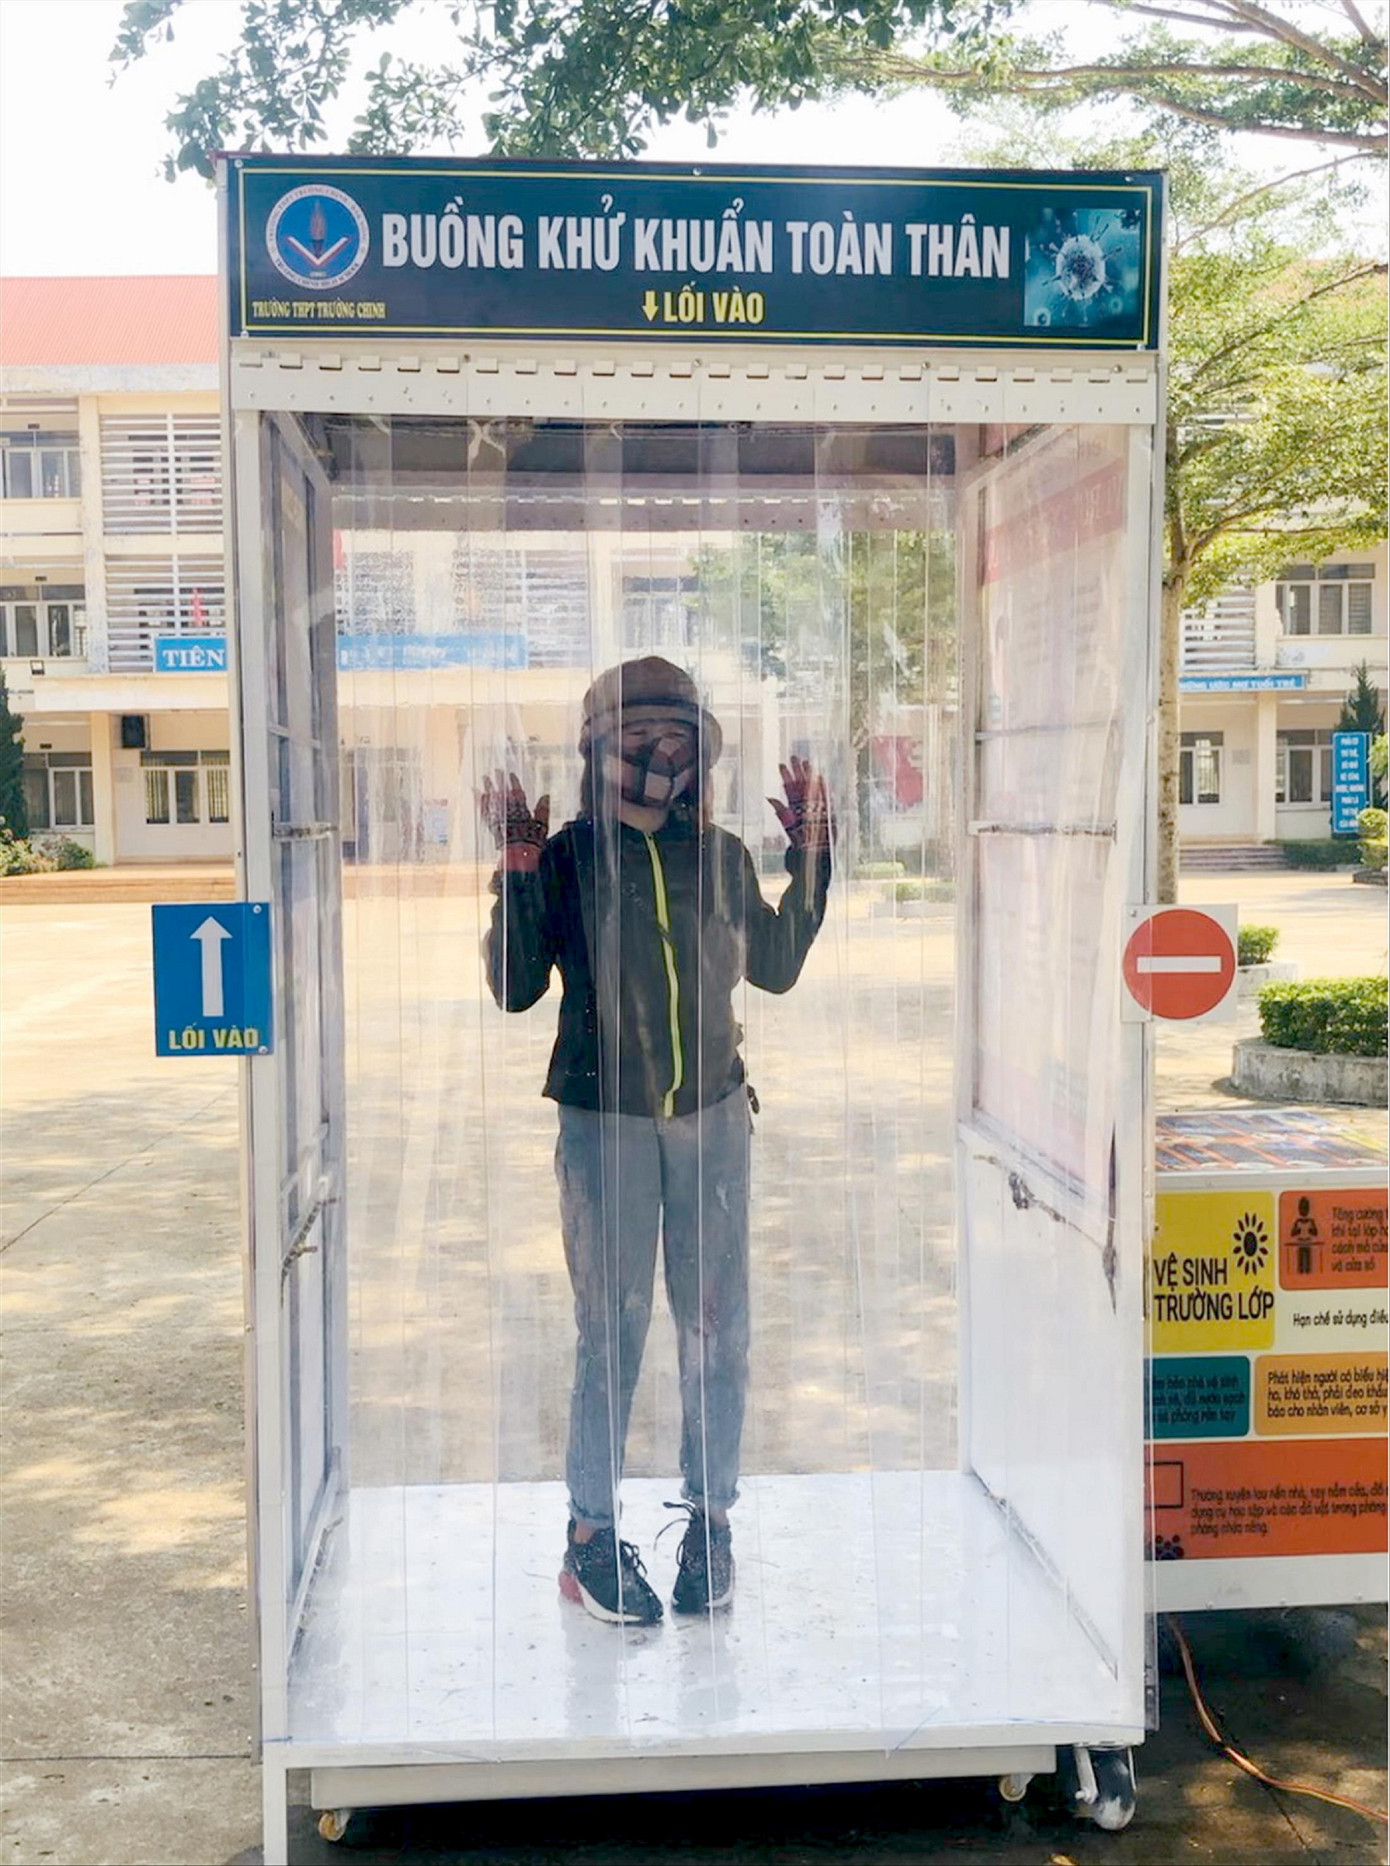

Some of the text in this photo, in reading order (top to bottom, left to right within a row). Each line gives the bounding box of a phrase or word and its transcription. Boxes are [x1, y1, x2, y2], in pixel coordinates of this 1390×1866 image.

[382, 196, 524, 269] BUỒNG
[538, 194, 626, 272] KHỬ
[634, 197, 773, 274] KHUẨN
[786, 210, 893, 276] TOÀN
[905, 213, 1010, 279] THÂN
[252, 297, 386, 318] TRƯỜNG THPT TRƯỜNG CHINH
[663, 280, 764, 325] LỐI VÀO
[162, 645, 225, 667] TIÊN
[168, 1021, 260, 1050] LỐI VÀO
[1153, 1252, 1227, 1292] VỆ SINH
[1154, 1286, 1274, 1321] TRƯỜNG LỚP
[1293, 1313, 1311, 1329] Hạn
[1313, 1310, 1330, 1326] chế
[1332, 1309, 1344, 1325] sử
[1345, 1309, 1367, 1329] dụng
[1267, 1370, 1289, 1384] Phát
[1292, 1369, 1312, 1386] hiện
[1314, 1369, 1338, 1387] người
[1354, 1366, 1374, 1382] biểu
[1323, 1384, 1343, 1403] phải
[1345, 1384, 1365, 1399] đeo
[1288, 1402, 1305, 1417] cho
[1307, 1402, 1329, 1417] nhân
